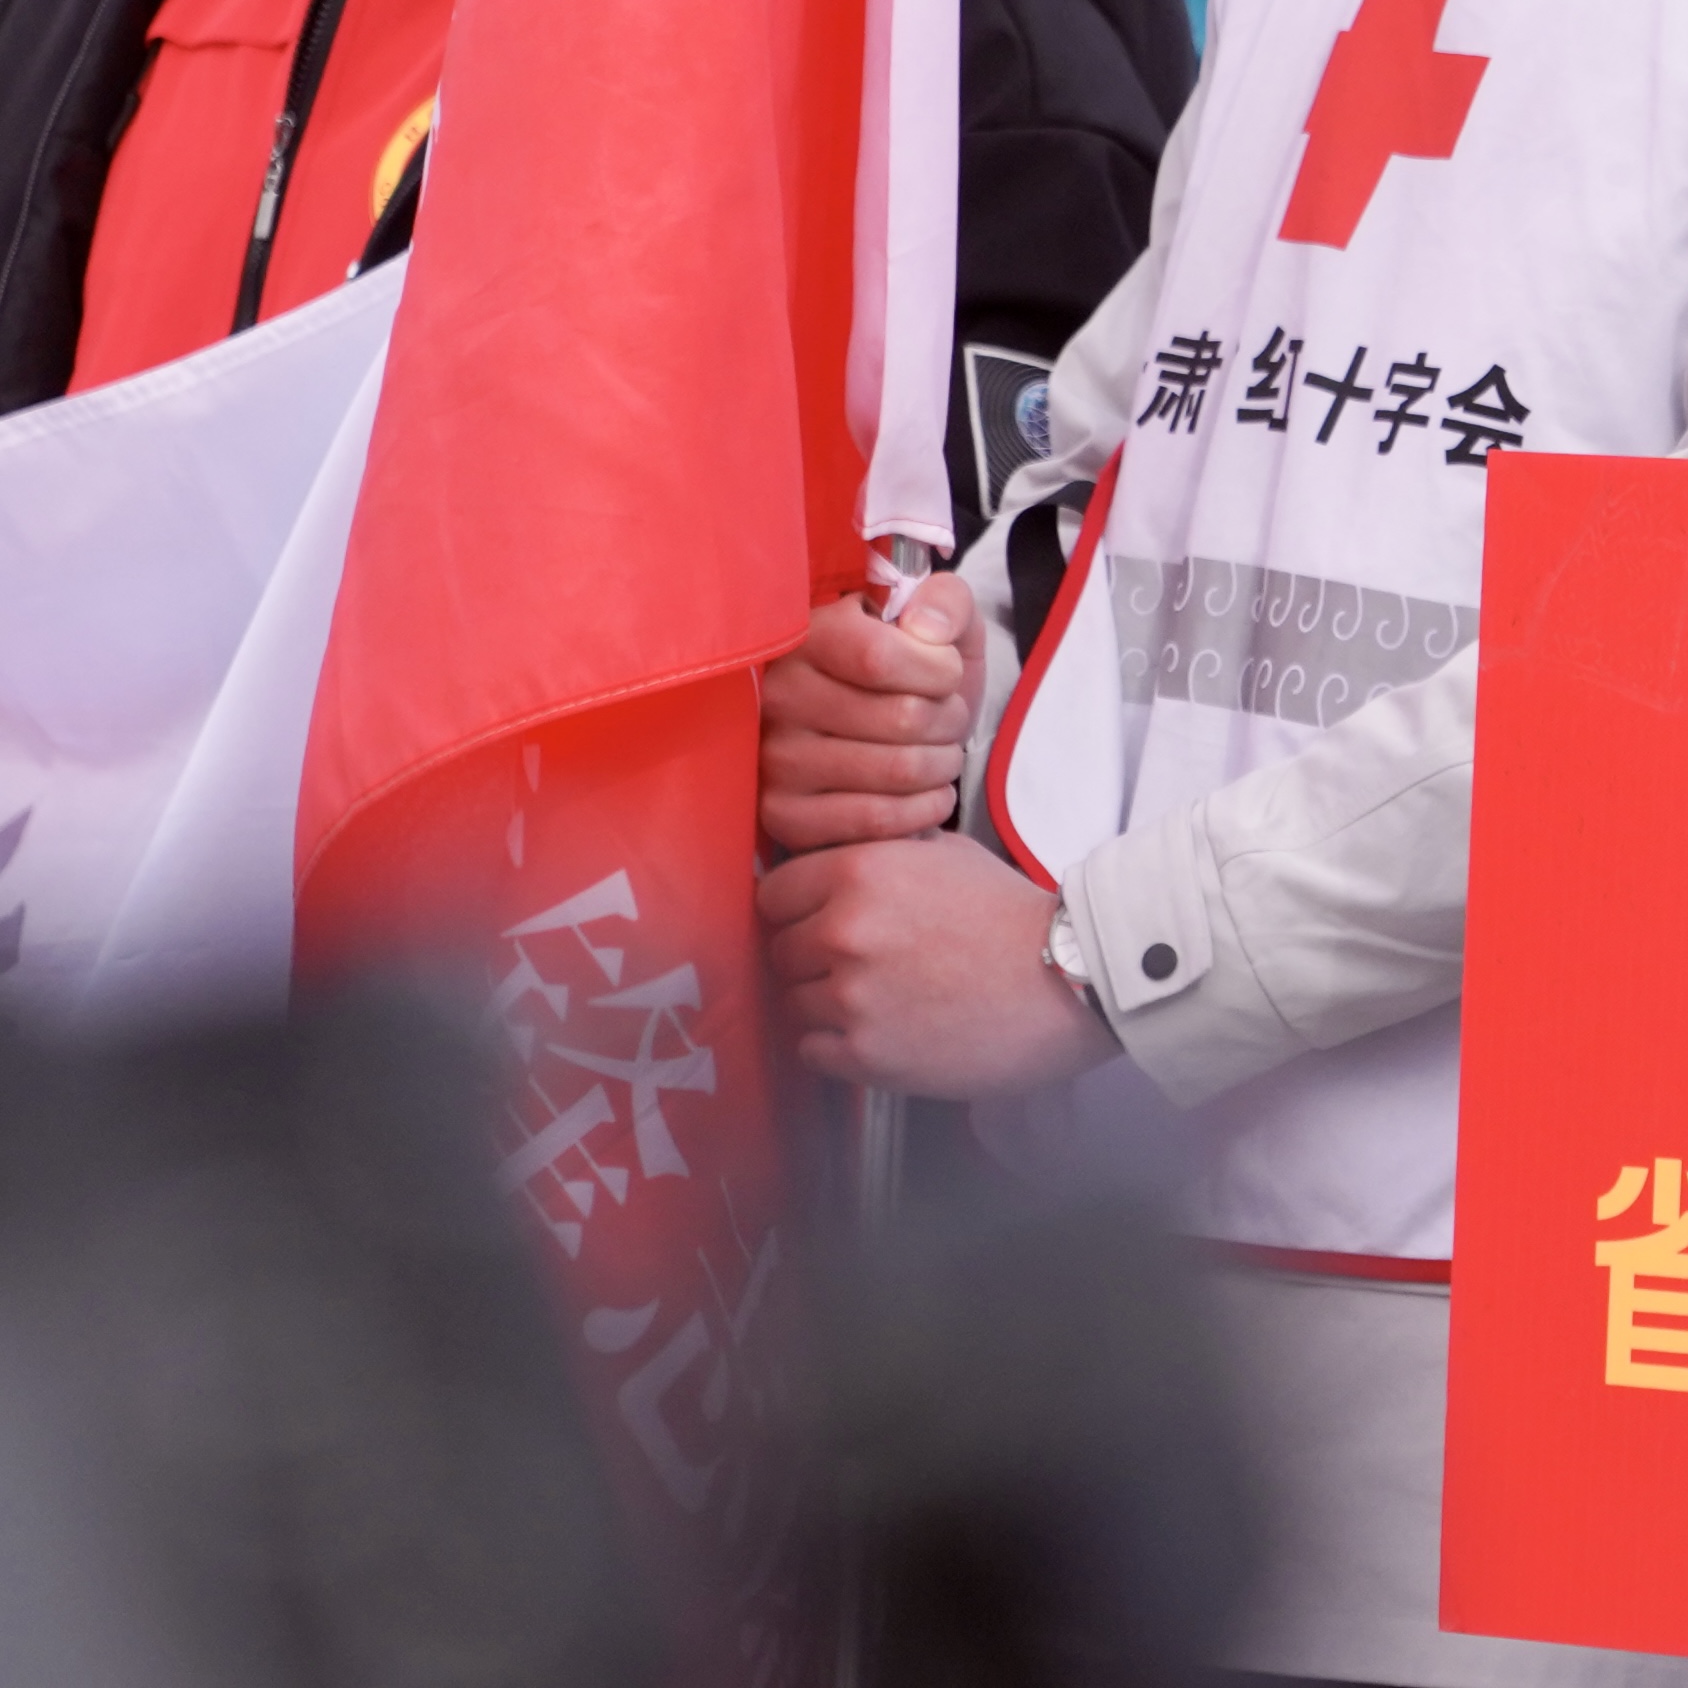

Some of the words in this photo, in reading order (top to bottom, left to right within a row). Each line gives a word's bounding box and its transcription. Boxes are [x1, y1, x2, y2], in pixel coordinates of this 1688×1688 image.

[1137, 326, 1531, 468] 肃红十字会
